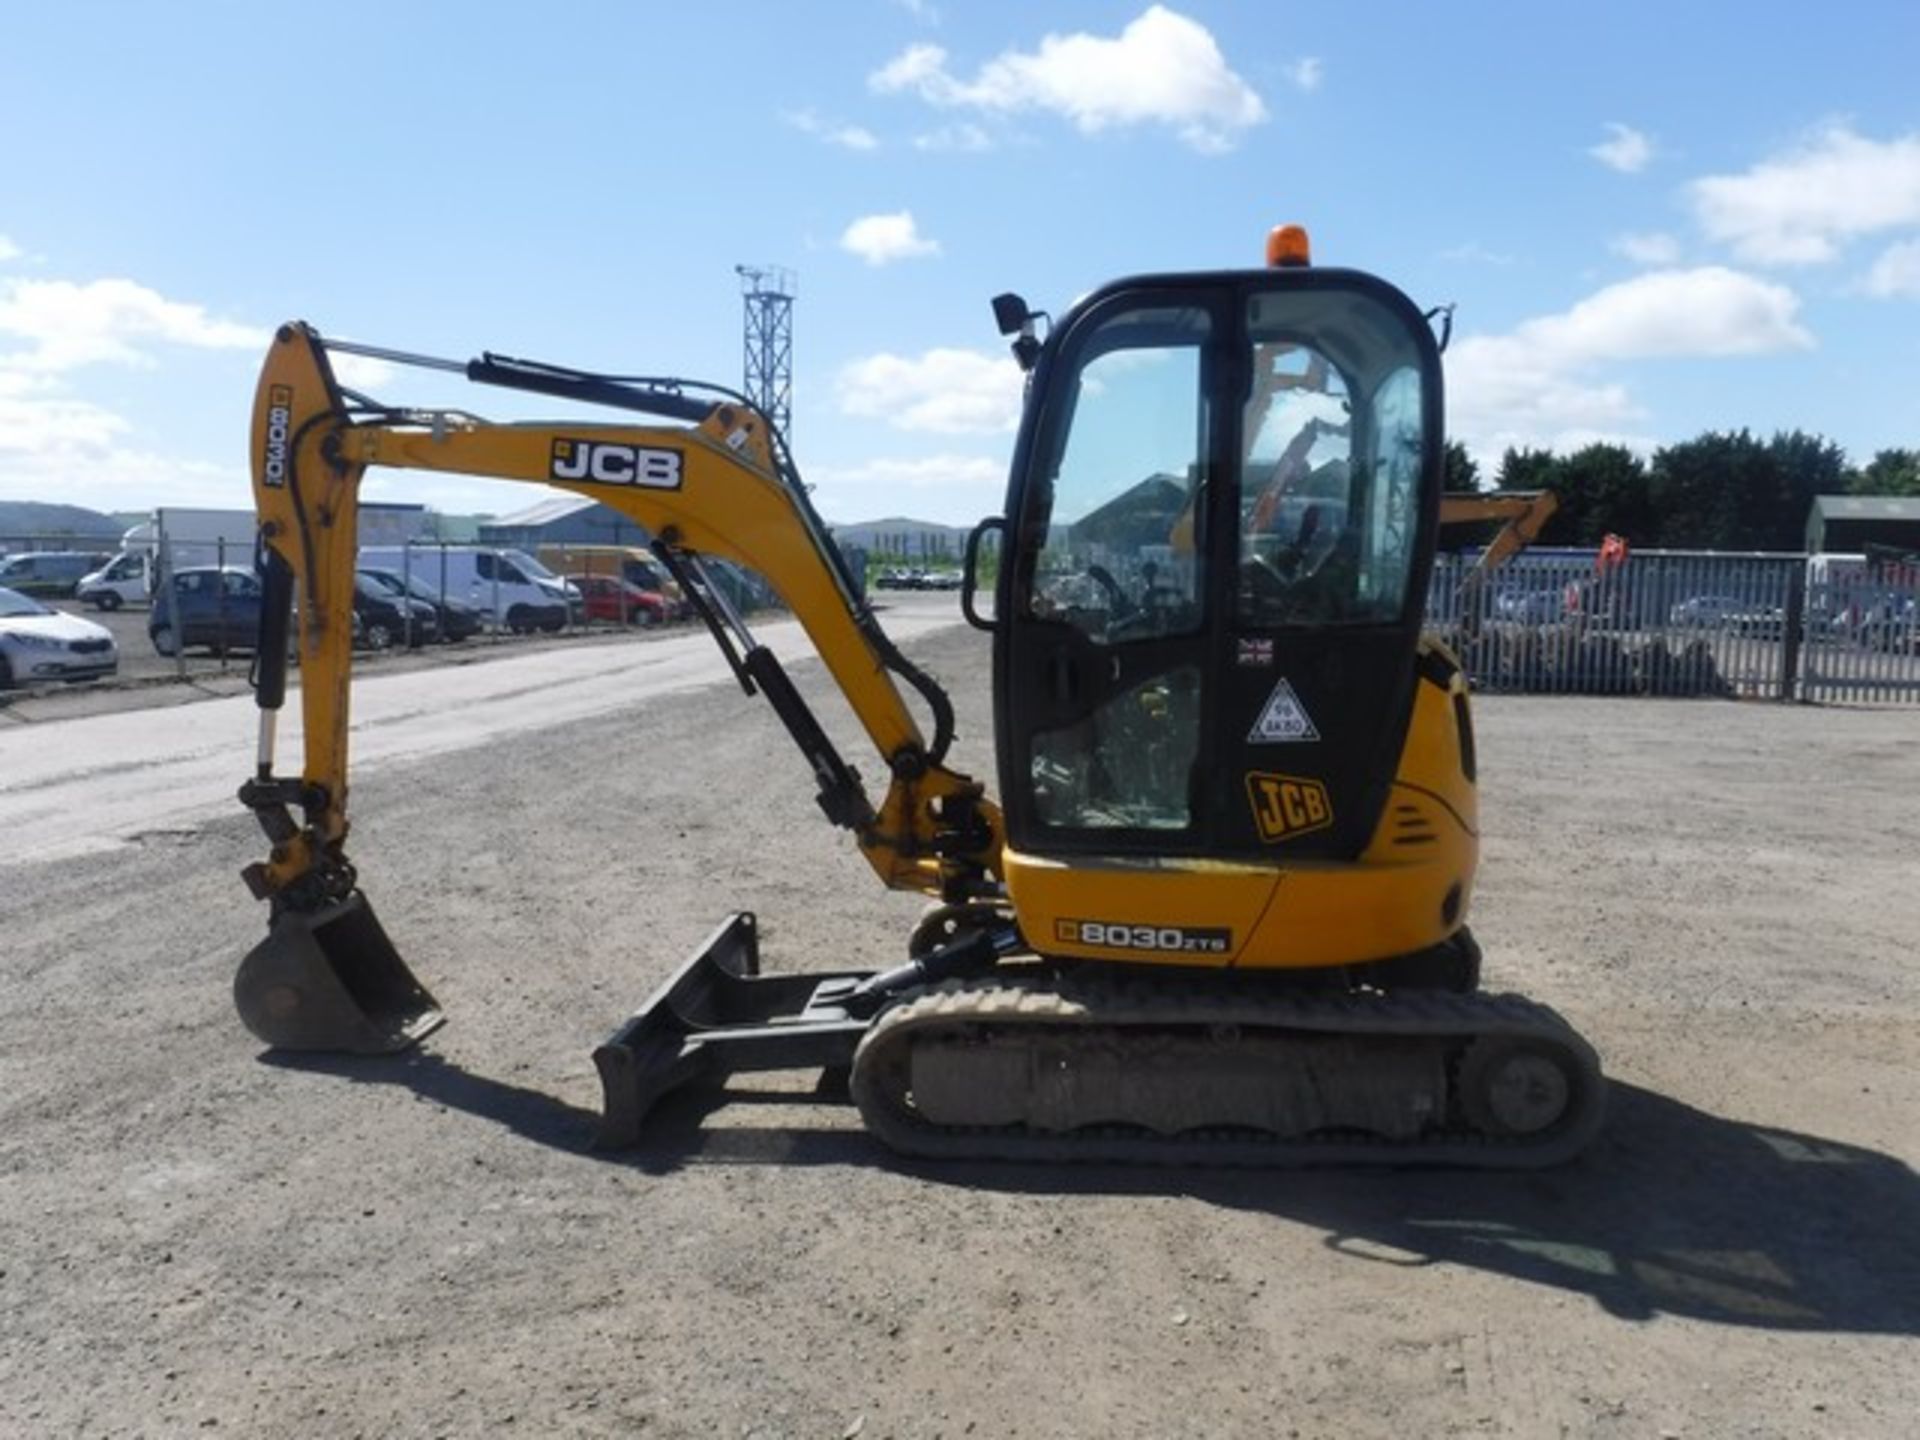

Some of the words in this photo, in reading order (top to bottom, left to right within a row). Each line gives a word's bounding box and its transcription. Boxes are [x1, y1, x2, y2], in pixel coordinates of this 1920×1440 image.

[266, 407, 289, 479] 8030
[554, 442, 680, 488] JCB
[1259, 779, 1326, 836] JCB
